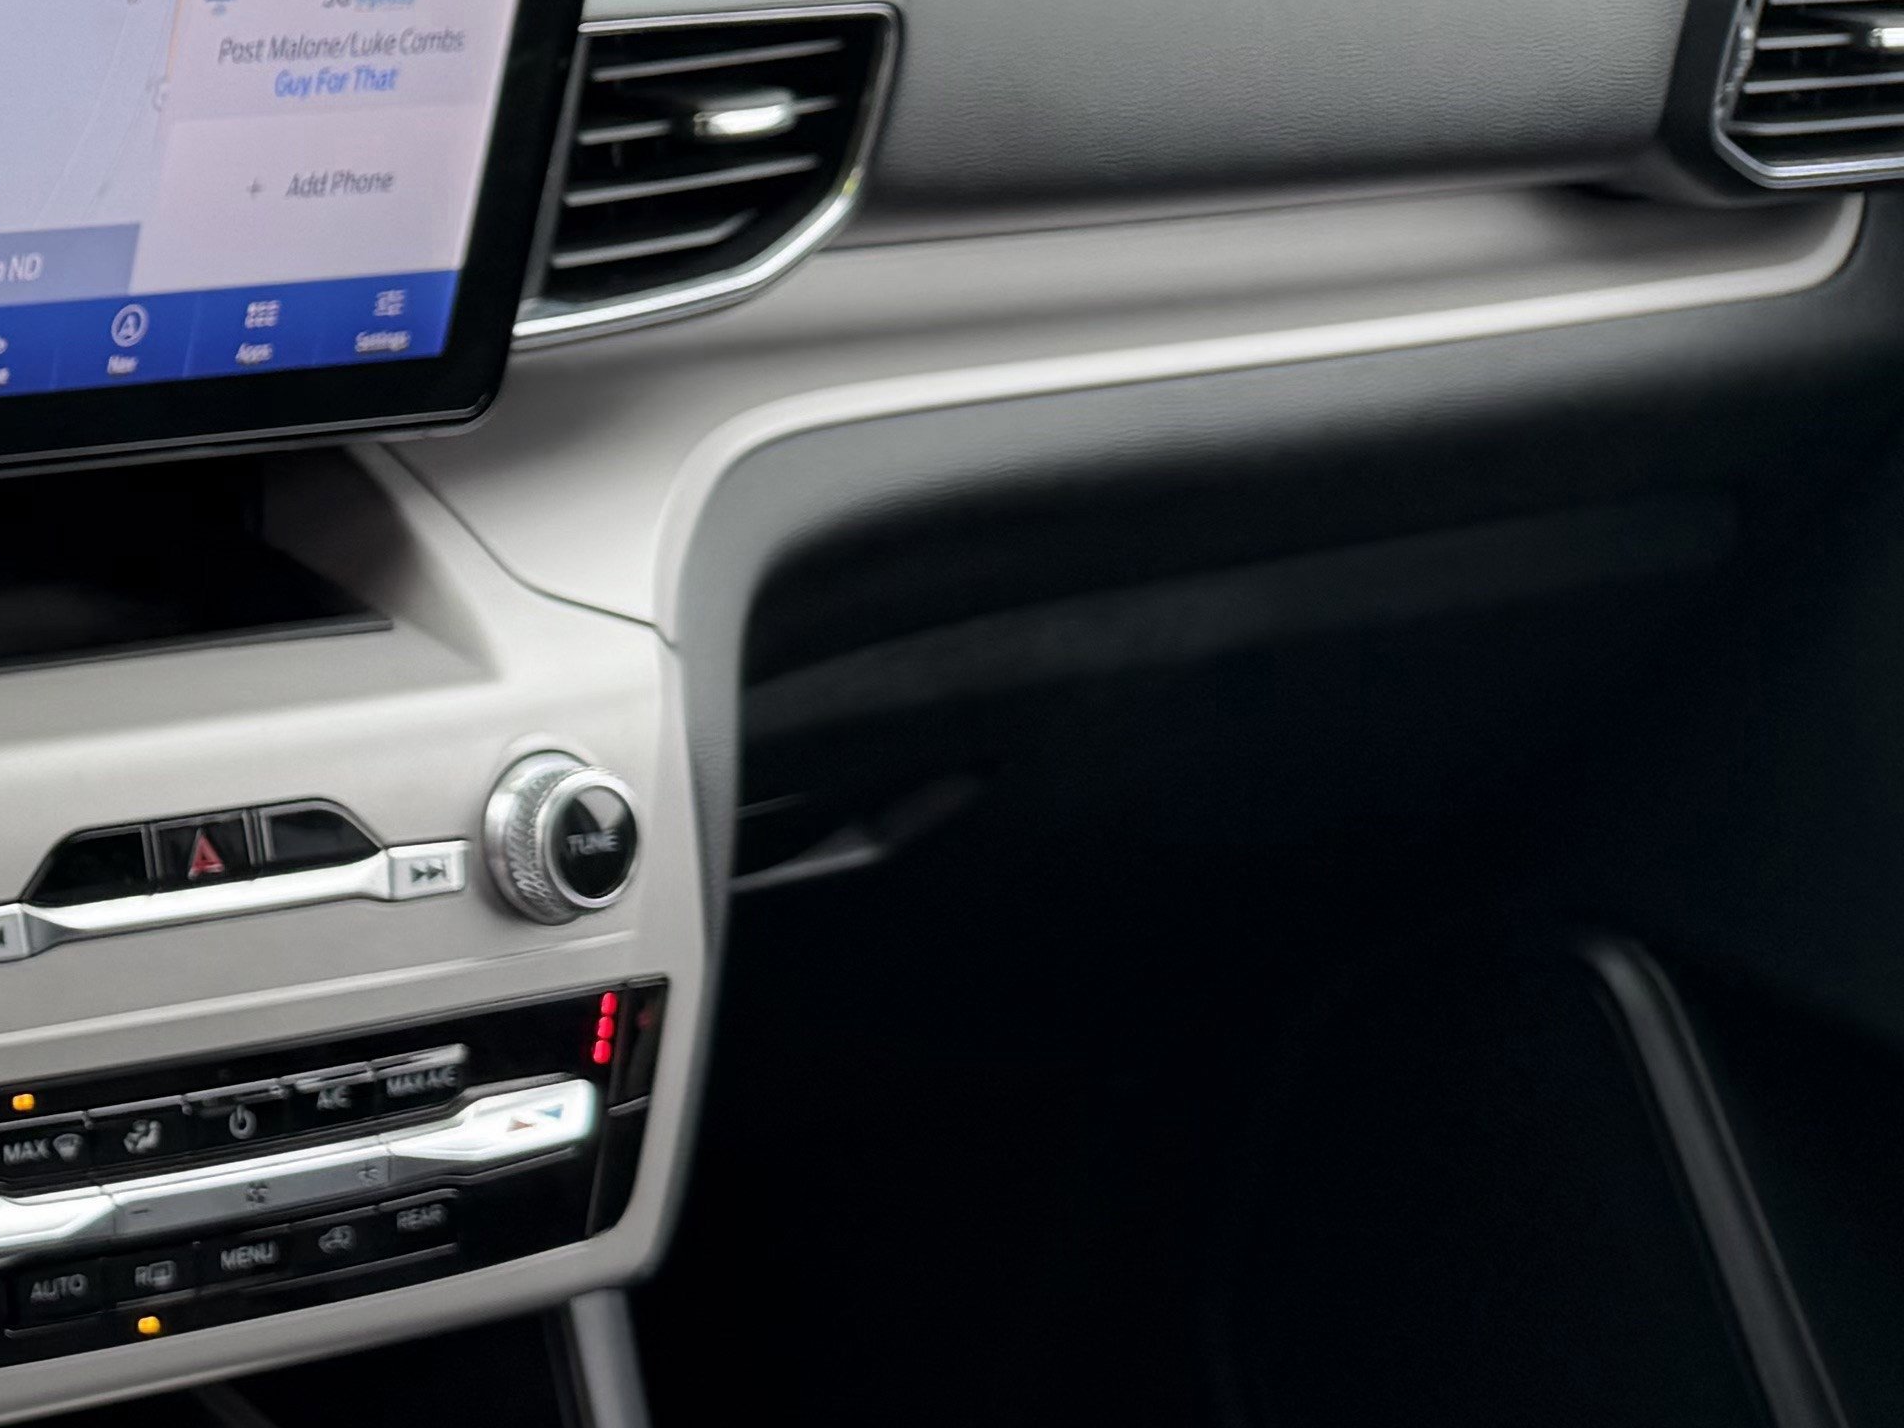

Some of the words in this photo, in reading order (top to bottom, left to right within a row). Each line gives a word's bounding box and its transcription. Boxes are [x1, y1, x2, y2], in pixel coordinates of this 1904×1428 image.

[219, 35, 264, 62] Post
[399, 27, 465, 54] Combs
[274, 69, 312, 98] Guy
[317, 68, 348, 94] For
[352, 66, 396, 91] That
[287, 170, 324, 195] Add
[328, 169, 392, 194] Phone
[8, 254, 42, 281] ND
[1, 1137, 51, 1162] MAX
[220, 1240, 277, 1270] MENU
[30, 1272, 88, 1301] AUTO
